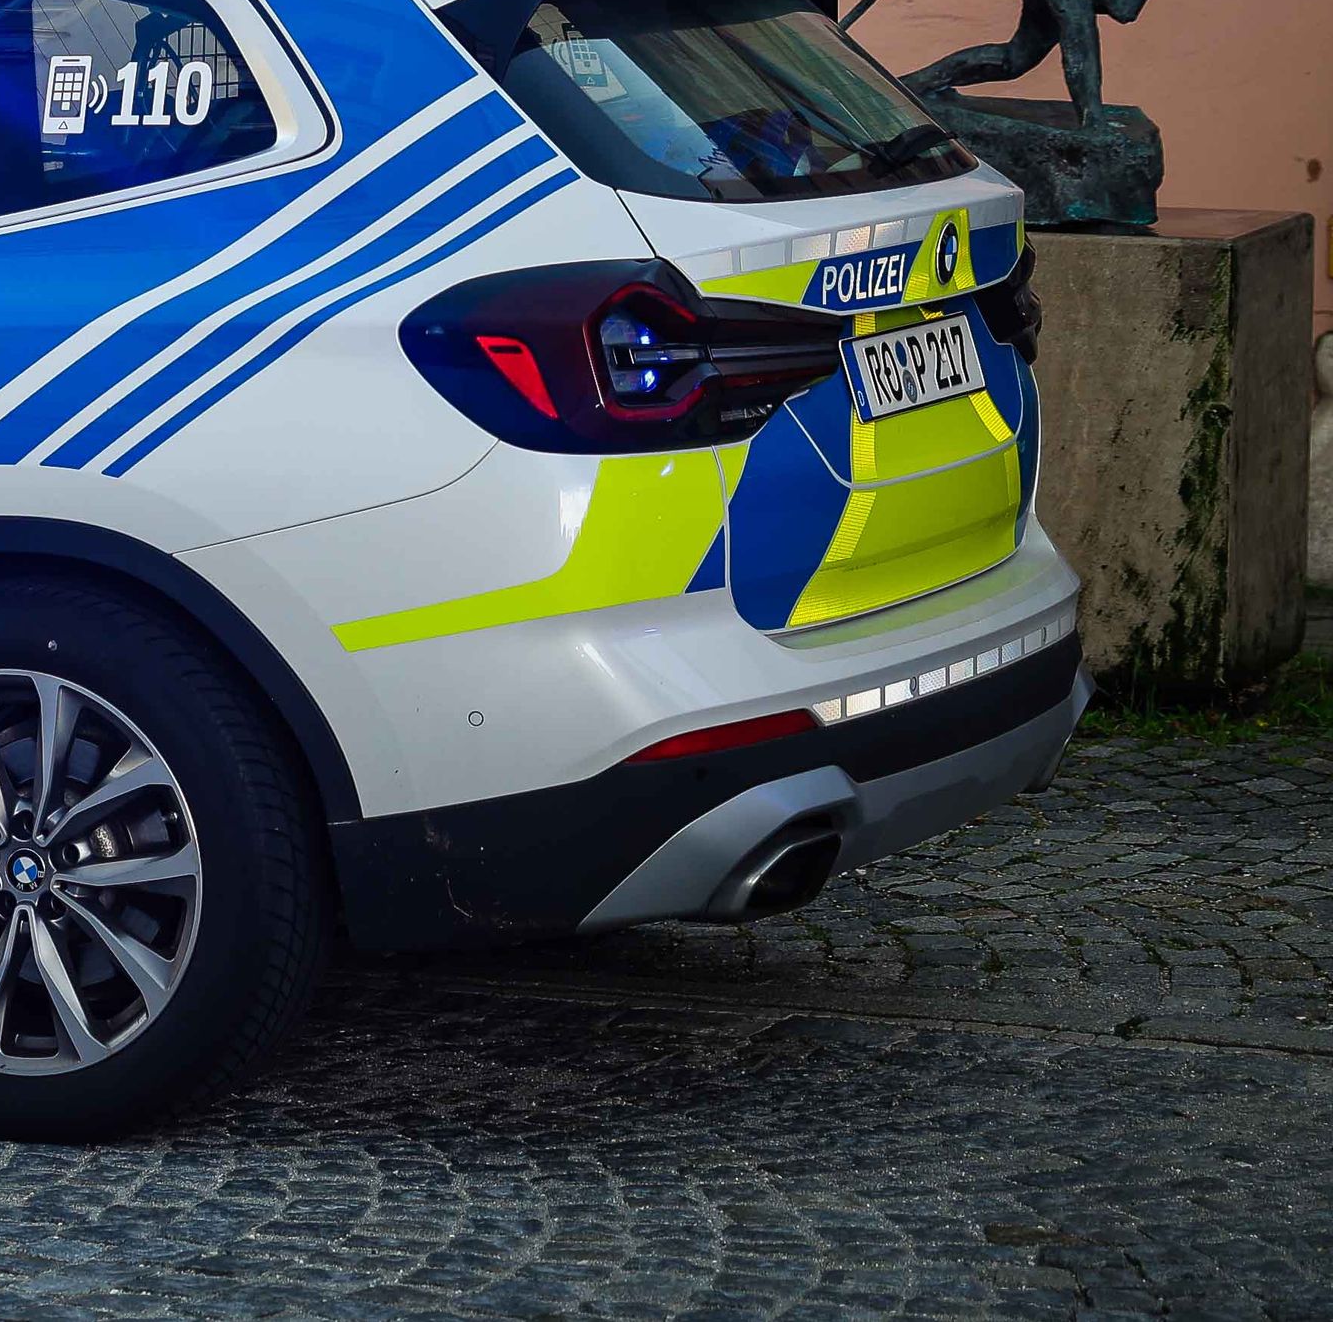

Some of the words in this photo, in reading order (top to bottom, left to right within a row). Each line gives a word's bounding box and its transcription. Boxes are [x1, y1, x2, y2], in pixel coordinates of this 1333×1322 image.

[111, 61, 213, 126] 110
[821, 252, 906, 306] POLIZEI
[925, 325, 970, 390] 217
